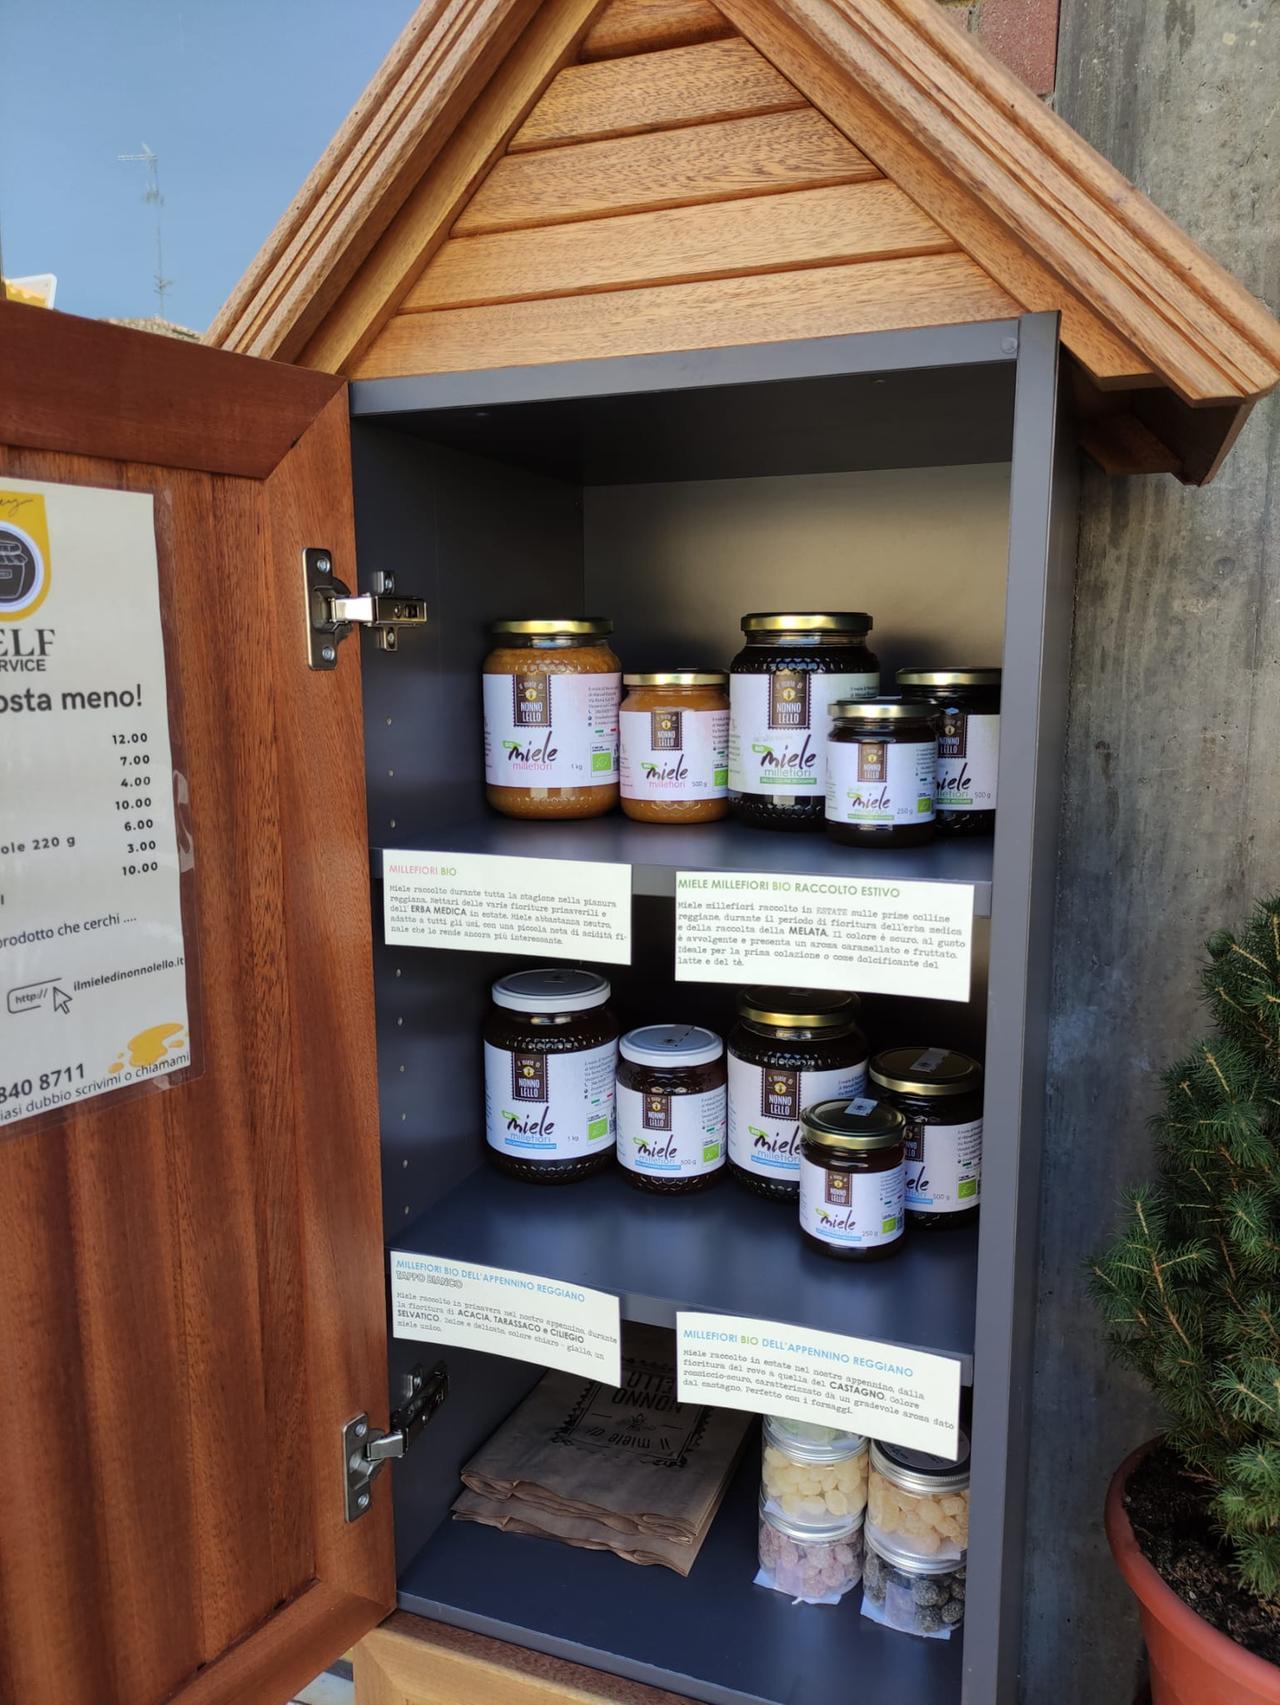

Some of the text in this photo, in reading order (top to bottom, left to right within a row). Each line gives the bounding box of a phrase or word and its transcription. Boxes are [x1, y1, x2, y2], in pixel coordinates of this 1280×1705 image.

[62, 683, 142, 710] meno!
[520, 702, 542, 712] NONNO
[776, 702, 801, 713] NONNO
[522, 712, 541, 722] LELLO
[779, 712, 799, 724] LELLO
[112, 732, 148, 744] 12.00
[508, 730, 558, 764] miele
[120, 754, 150, 766] 7.00
[761, 734, 816, 770] miele
[646, 754, 688, 781] miele
[764, 767, 811, 778] millefiori
[120, 776, 150, 788] 4.00
[115, 798, 152, 810] 10.00
[852, 786, 890, 810] miele
[124, 818, 154, 832] 6.00
[32, 836, 60, 850] 220
[66, 836, 76, 848] g
[128, 840, 156, 854] 3.00
[122, 862, 158, 876] 10.00
[389, 865, 456, 876] MILLEFIORI BIO
[678, 880, 900, 898] MIELE MILLEFIORI BIO RACCOLTO ESTIVO
[411, 905, 431, 914] ERBA
[434, 906, 468, 916] MEDICA
[678, 902, 702, 910] Miele
[706, 902, 754, 911] millefiori
[758, 904, 798, 913] raccolto
[851, 910, 878, 918] sulle
[882, 911, 909, 920] prime
[913, 913, 950, 923] colline
[58, 922, 81, 936] che
[84, 912, 120, 931] cerchi
[73, 957, 184, 992] ilmieledinonnolello.it
[26, 1090, 72, 1113] dubbio
[75, 1074, 122, 1097] scrivimi
[124, 1072, 132, 1082] o
[136, 1052, 190, 1078] chiamami
[39, 1063, 85, 1091] 8711
[519, 1078, 540, 1088] NONNO
[520, 1088, 538, 1098] LELLO
[769, 1094, 792, 1106] NONNO
[770, 1104, 790, 1116] LELLO
[507, 1106, 554, 1136] miele
[638, 1134, 678, 1160] miele
[757, 1150, 800, 1163] millefior
[904, 1166, 929, 1193] ele
[820, 1210, 856, 1231] miele
[396, 1260, 442, 1273] MILLEFIORI
[444, 1267, 458, 1276] BIO
[537, 1284, 584, 1302] REGGIANO
[494, 1316, 541, 1332] TARASSACO
[550, 1328, 584, 1344] CILIEGIO
[684, 1330, 738, 1342] MILLEFIORI
[740, 1336, 758, 1346] BIO
[853, 1356, 913, 1377] REGGIANO
[627, 1372, 674, 1394] ELLO
[611, 1388, 682, 1414] NONNO
[608, 1433, 650, 1449] miele
